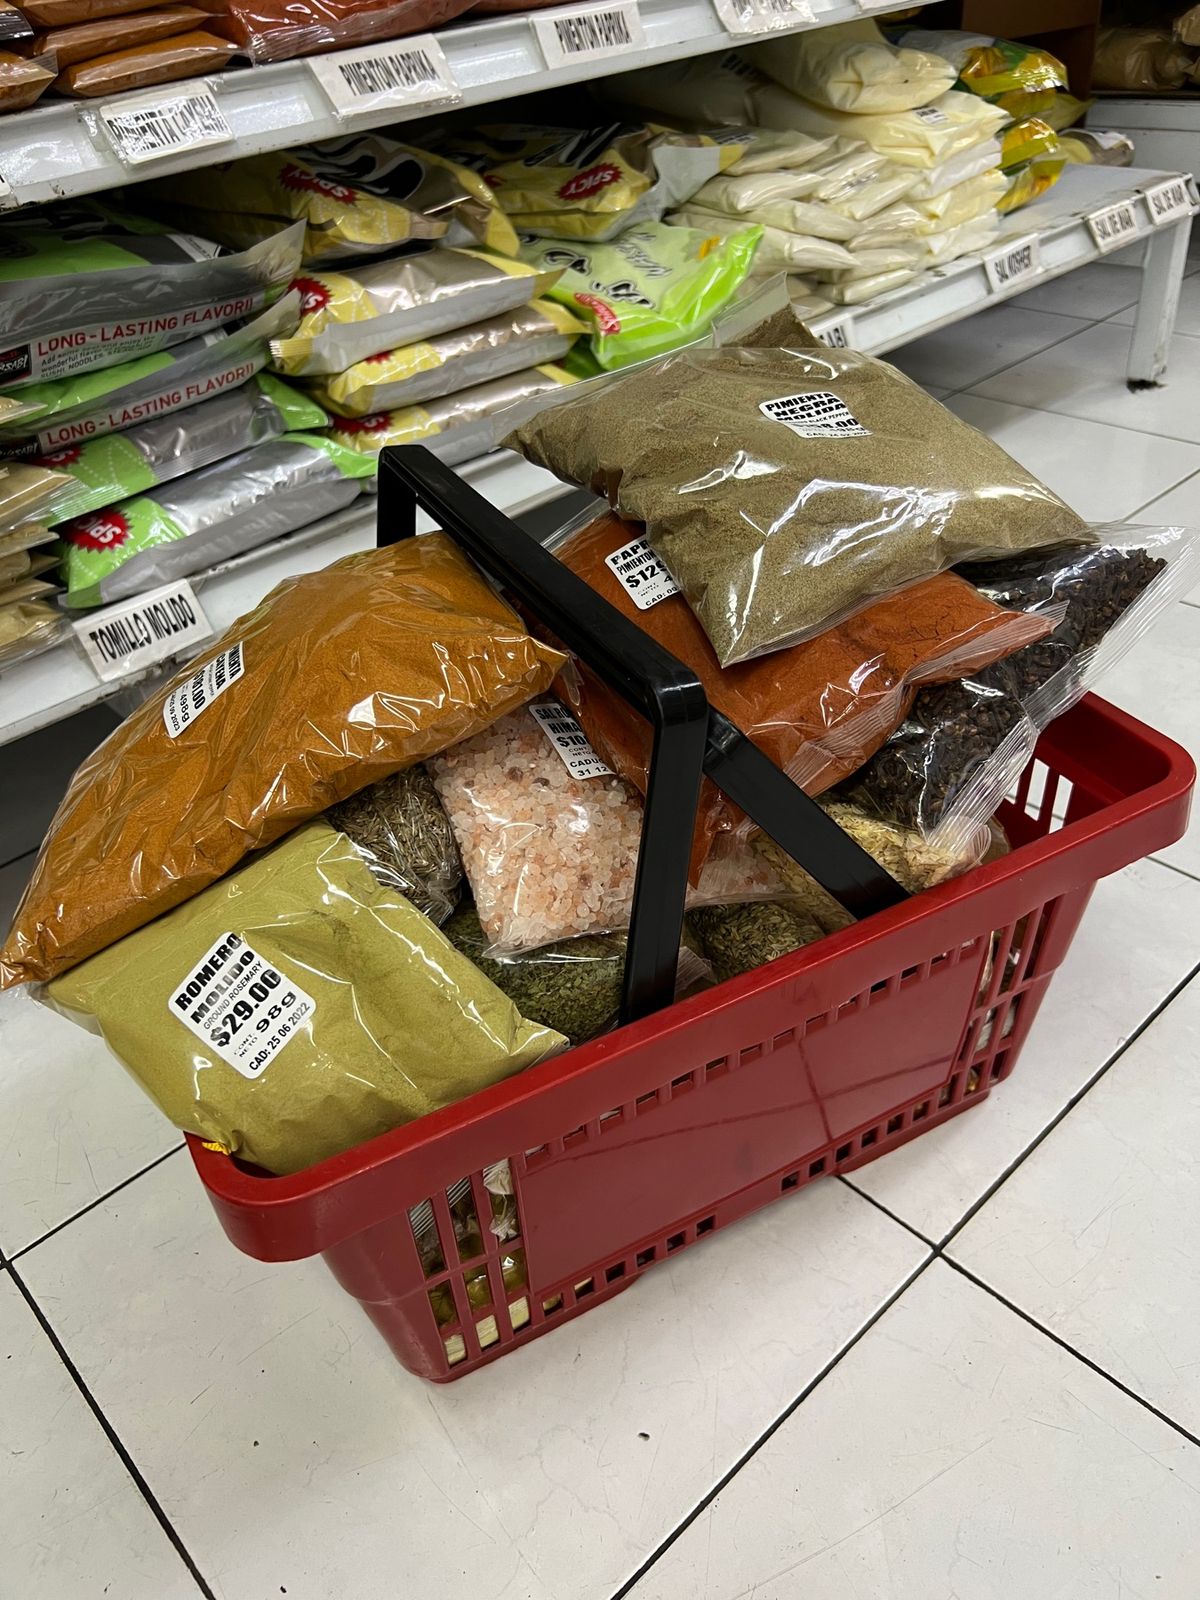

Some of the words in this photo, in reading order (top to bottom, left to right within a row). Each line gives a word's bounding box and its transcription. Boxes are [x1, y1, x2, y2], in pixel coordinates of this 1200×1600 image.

[566, 169, 615, 195] SPICY
[42, 354, 56, 366] Add
[765, 393, 835, 412] PIMIENTA
[773, 397, 842, 418] NEGRA
[776, 403, 847, 421] MOLIDA
[616, 549, 657, 576] PIMIENTON
[645, 593, 666, 607] CAD:
[89, 612, 152, 663] TOMILLO
[142, 593, 196, 640] MOLIDO
[179, 693, 190, 723] 498g
[535, 707, 557, 719] SAL
[577, 769, 592, 777] 31
[174, 932, 243, 1012] ROMERO
[190, 950, 255, 1024] MOLIDO
[203, 1000, 231, 1030] GROUND
[228, 960, 264, 1001] ROSEMARY
[210, 968, 282, 1048] $29.00
[255, 991, 297, 1033] 98g
[248, 1049, 272, 1071] CAD:
[267, 1035, 281, 1050] 25
[277, 1023, 291, 1038] 06
[288, 1002, 311, 1026] 2022
